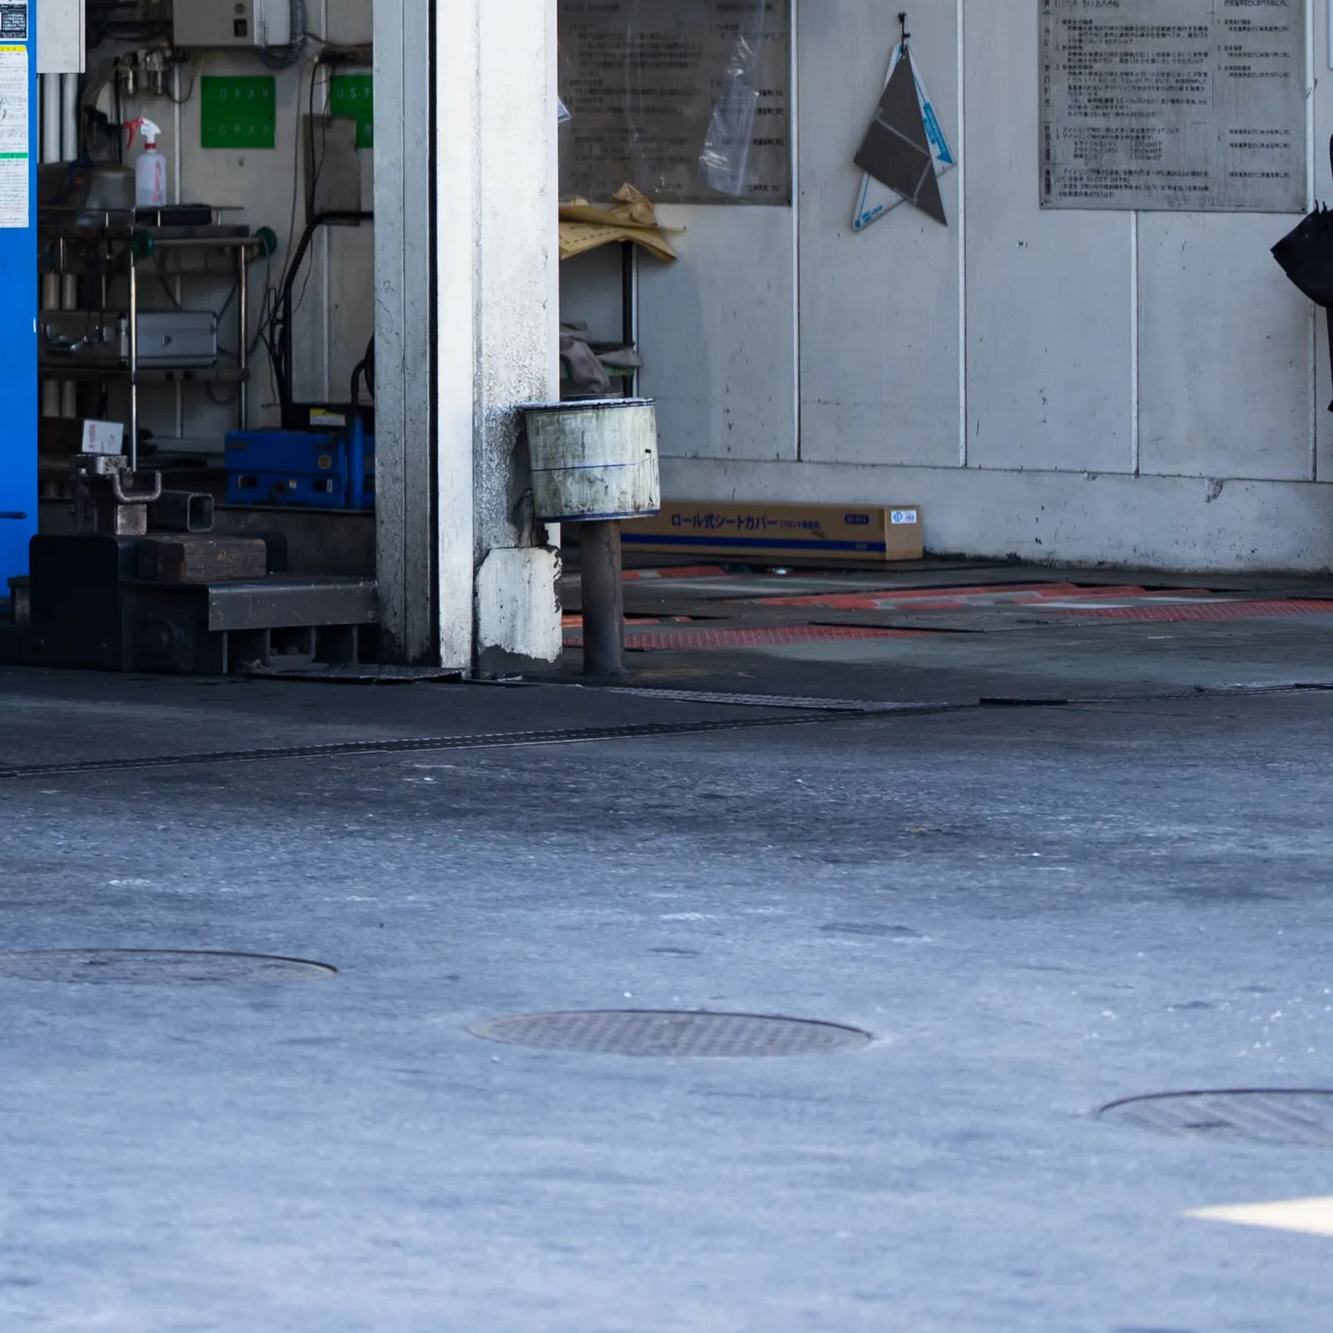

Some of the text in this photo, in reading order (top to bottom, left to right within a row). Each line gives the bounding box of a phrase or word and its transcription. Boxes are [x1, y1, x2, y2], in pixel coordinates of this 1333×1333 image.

[671, 512, 777, 531] ロール式シートカバー
